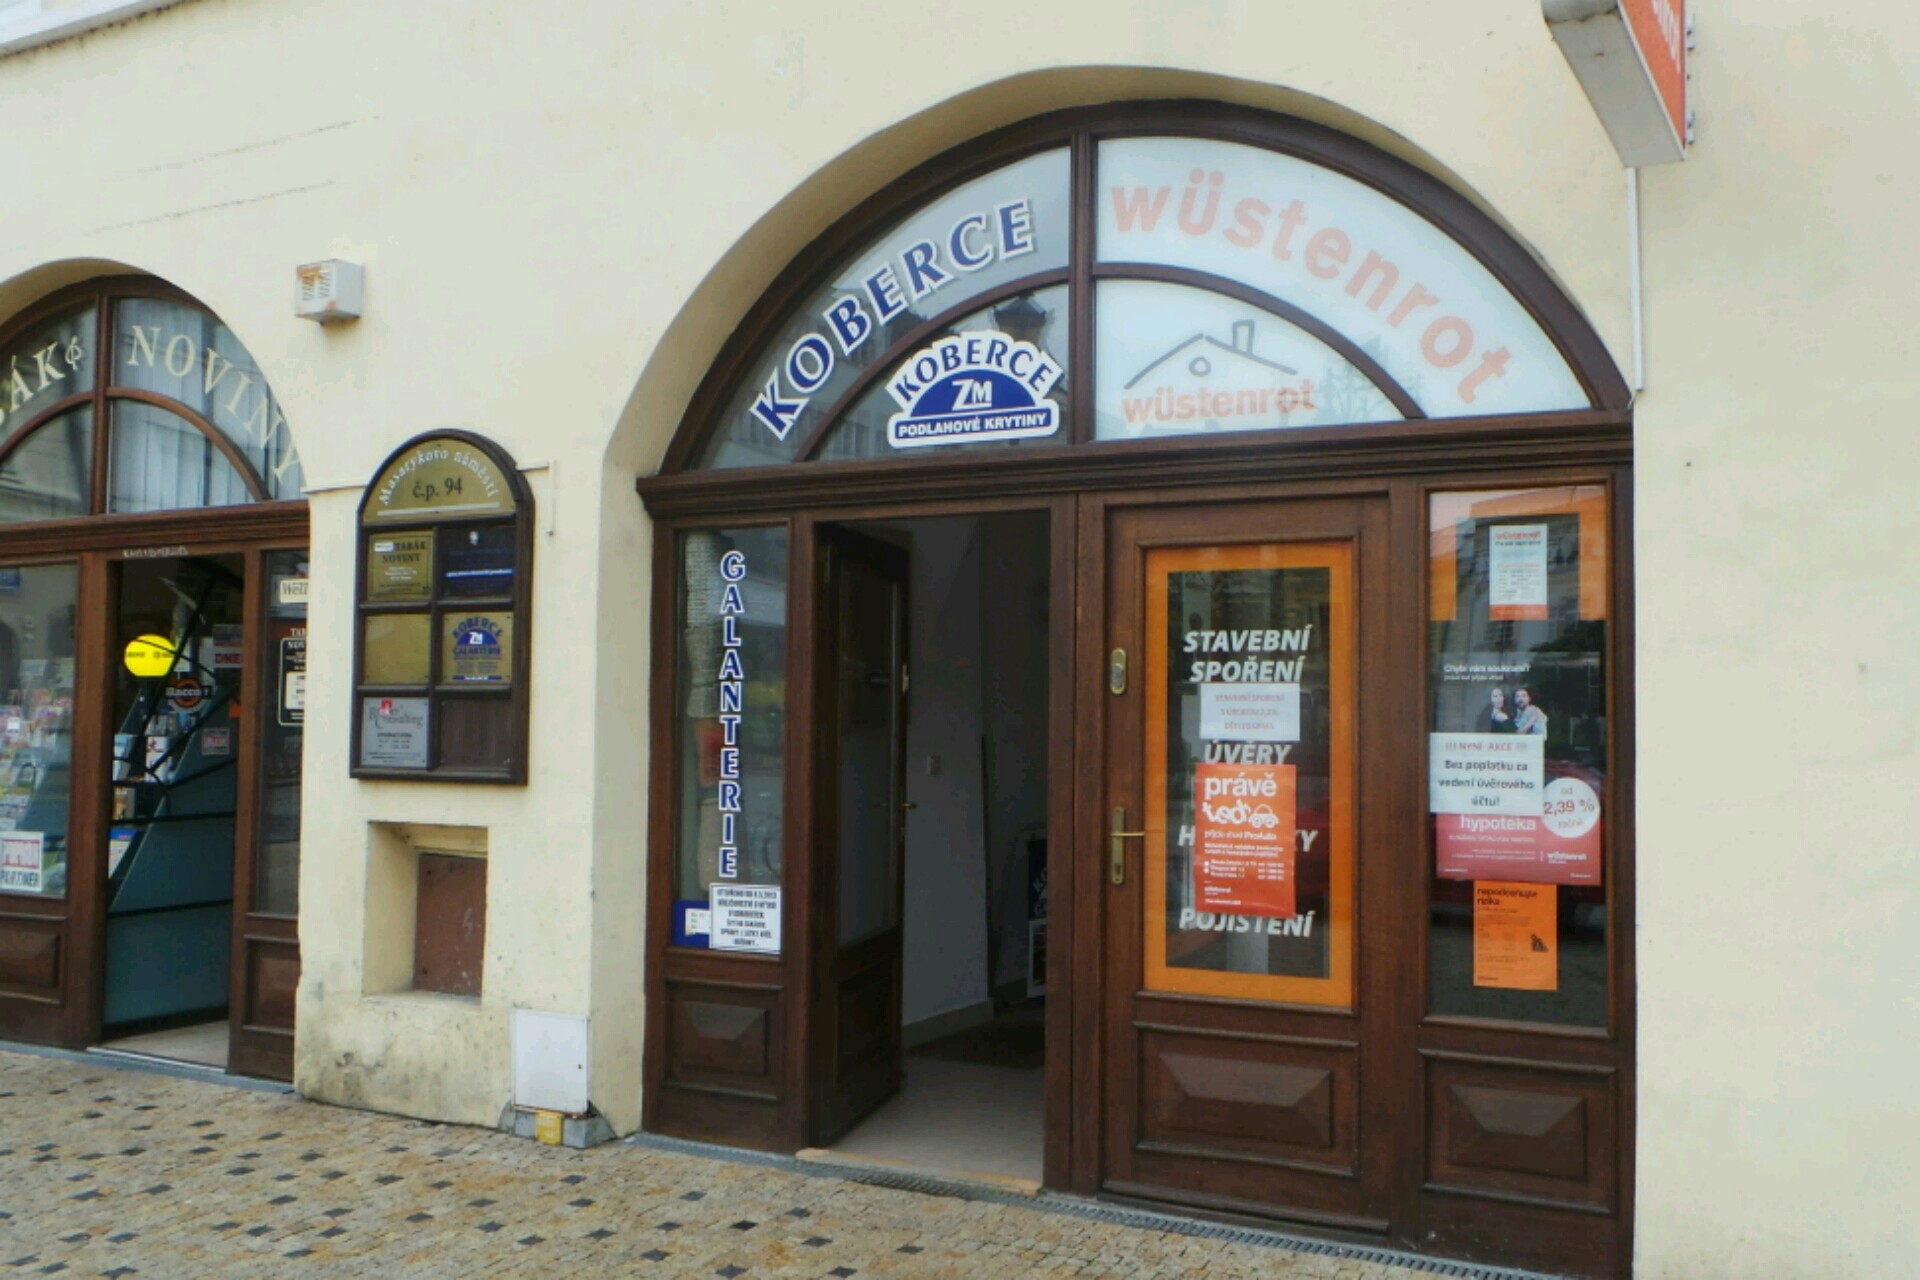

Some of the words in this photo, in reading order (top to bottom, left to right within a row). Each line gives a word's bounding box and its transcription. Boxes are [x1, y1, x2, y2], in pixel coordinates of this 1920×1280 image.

[1112, 168, 1515, 404] wüstenrot
[750, 197, 1036, 440] KOBERCE
[893, 337, 1054, 402] KOBERCE
[127, 324, 301, 485] NOVINY
[951, 378, 993, 412] ZM
[1122, 378, 1316, 424] wüstenrot
[898, 415, 981, 438] PODLAHOVÉ
[984, 411, 1047, 430] KRYTINY
[444, 477, 463, 495] 94
[1182, 623, 1314, 653] STAVEBNÍ
[1188, 654, 1307, 683] SPOŘENÍ
[719, 550, 746, 878] GALANTERIE
[1204, 739, 1293, 765] ÚVĚRY
[1444, 759, 1463, 770] Bez
[1516, 763, 1528, 771] za
[1204, 772, 1278, 800] právě
[1438, 775, 1475, 787] vedení
[1543, 801, 1576, 816] 2,39
